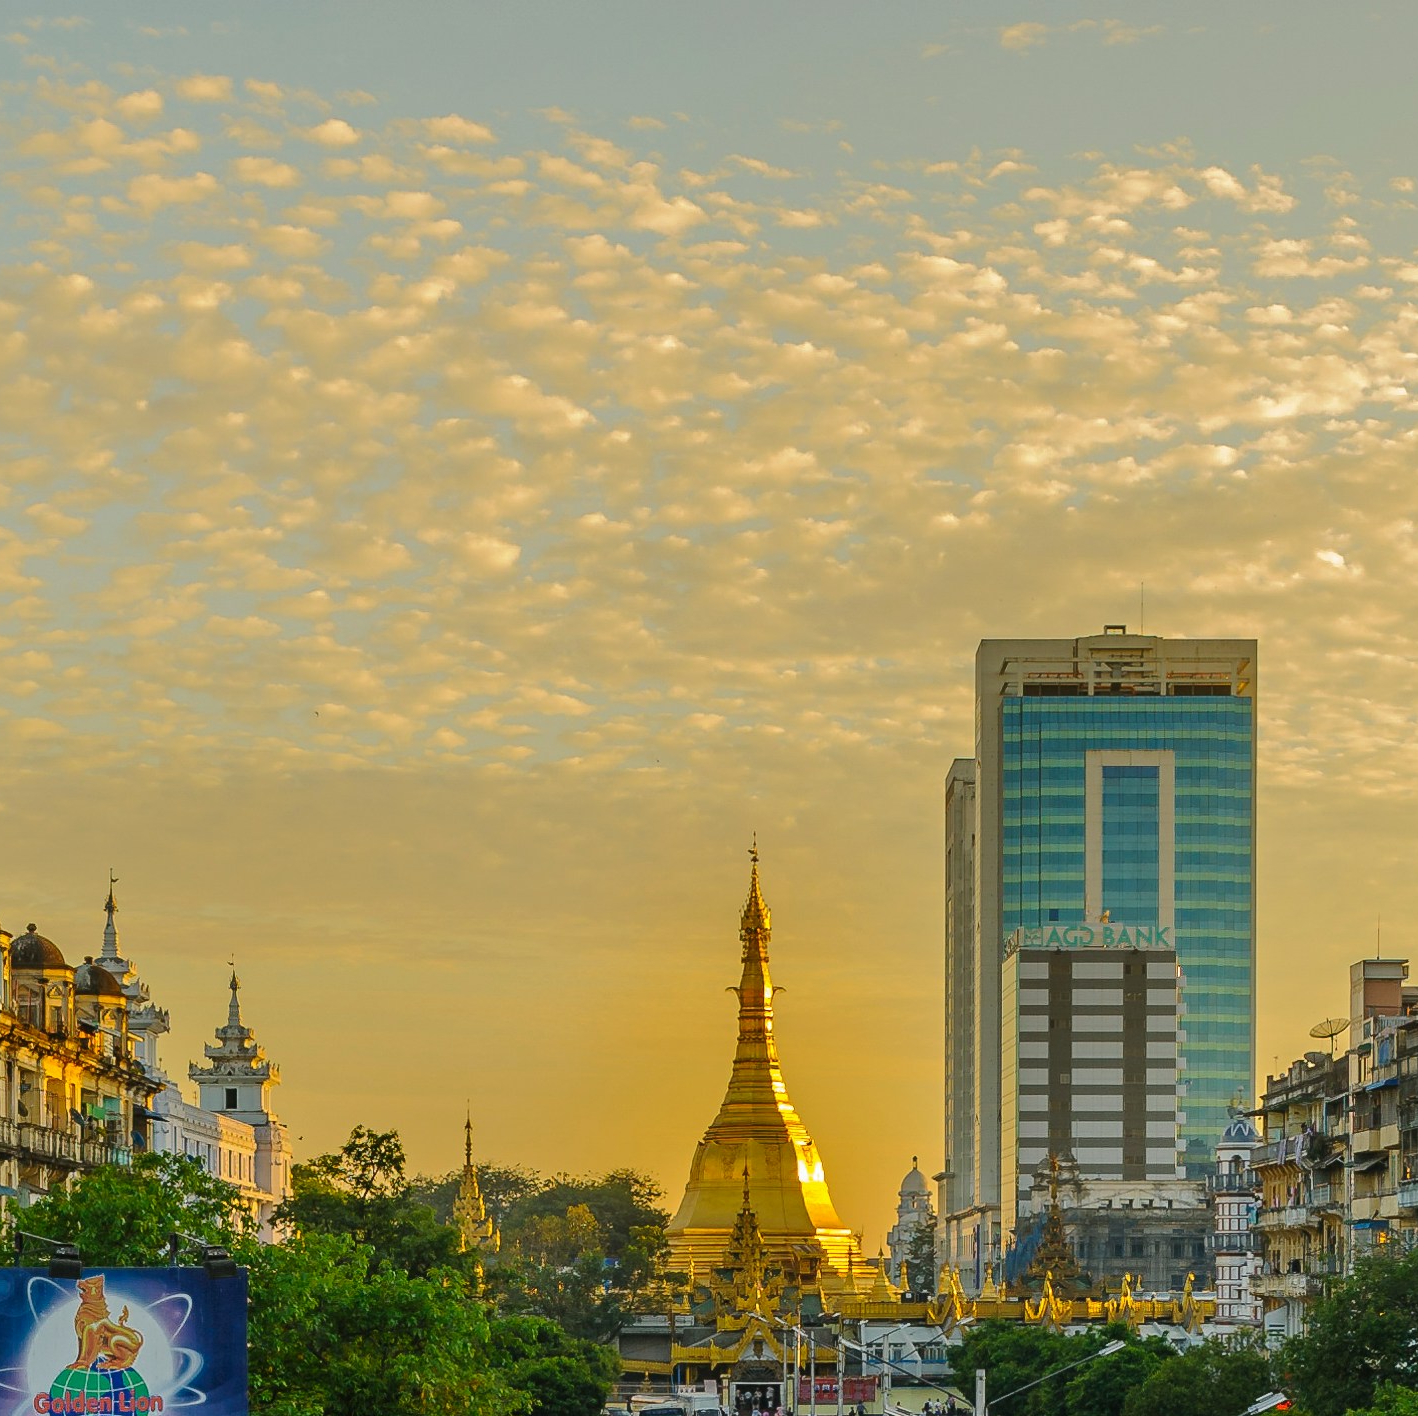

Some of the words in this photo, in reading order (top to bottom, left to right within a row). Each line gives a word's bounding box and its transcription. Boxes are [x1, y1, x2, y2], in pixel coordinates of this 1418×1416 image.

[1047, 926, 1095, 947] AGD
[1102, 926, 1170, 948] BANK
[33, 1389, 112, 1415] Golden
[118, 1388, 164, 1413] Lion
